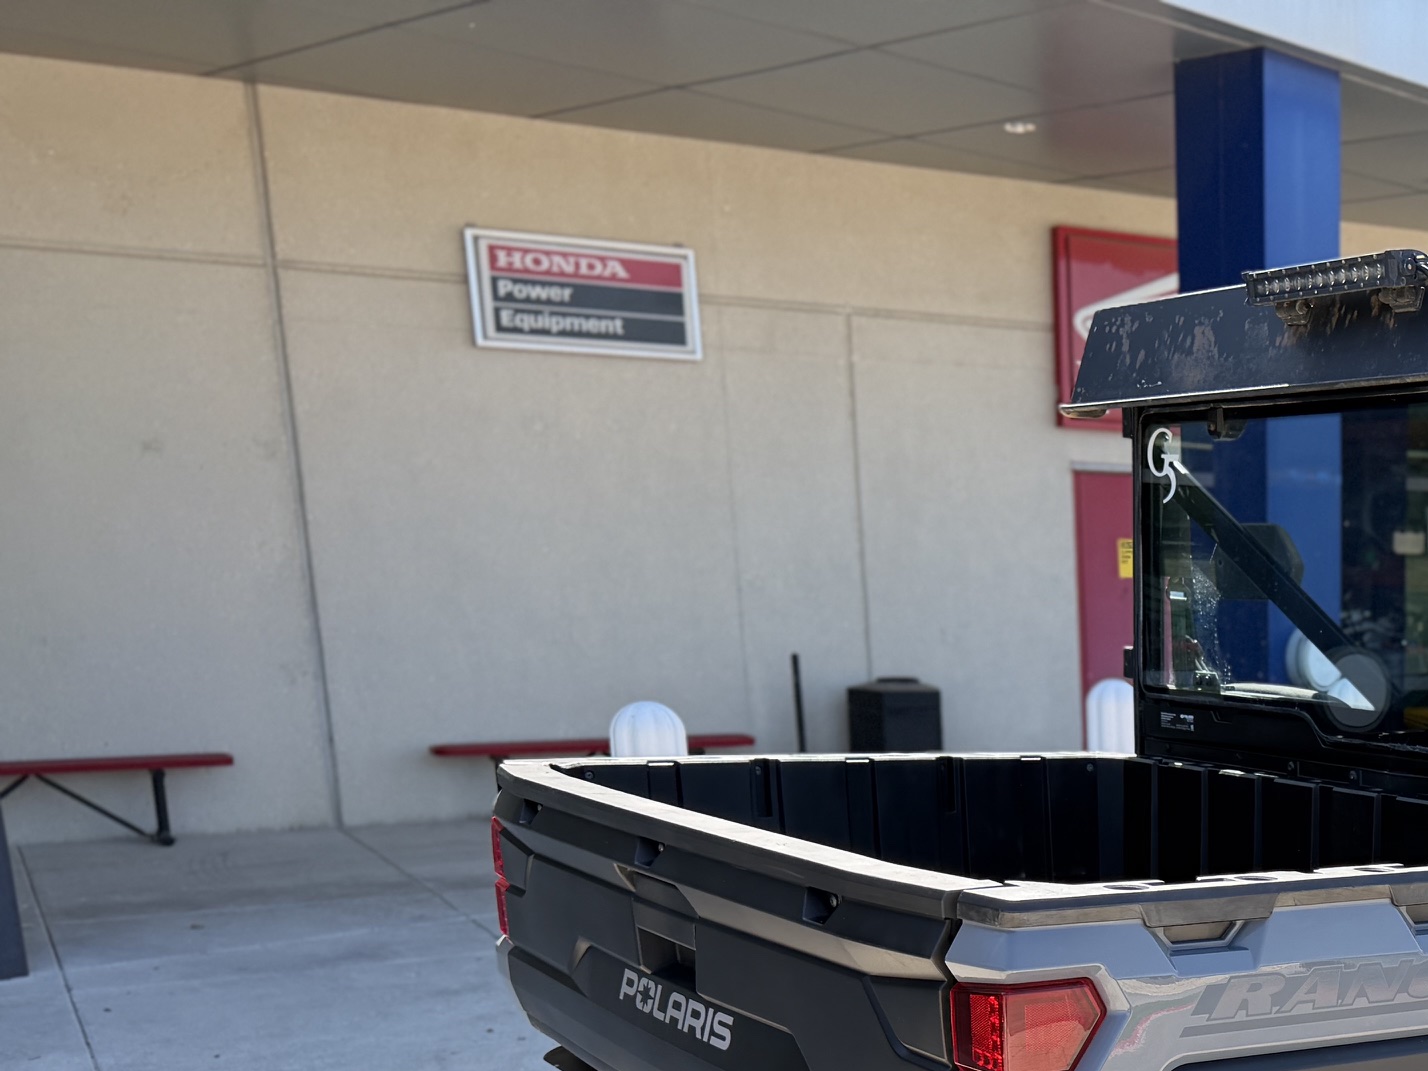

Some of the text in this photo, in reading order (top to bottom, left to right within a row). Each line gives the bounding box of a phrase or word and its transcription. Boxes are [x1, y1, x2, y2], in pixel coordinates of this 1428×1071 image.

[493, 248, 630, 279] HONDA
[496, 279, 573, 302] Power
[499, 309, 625, 336] Equipment
[618, 968, 735, 1051] POLARIS
